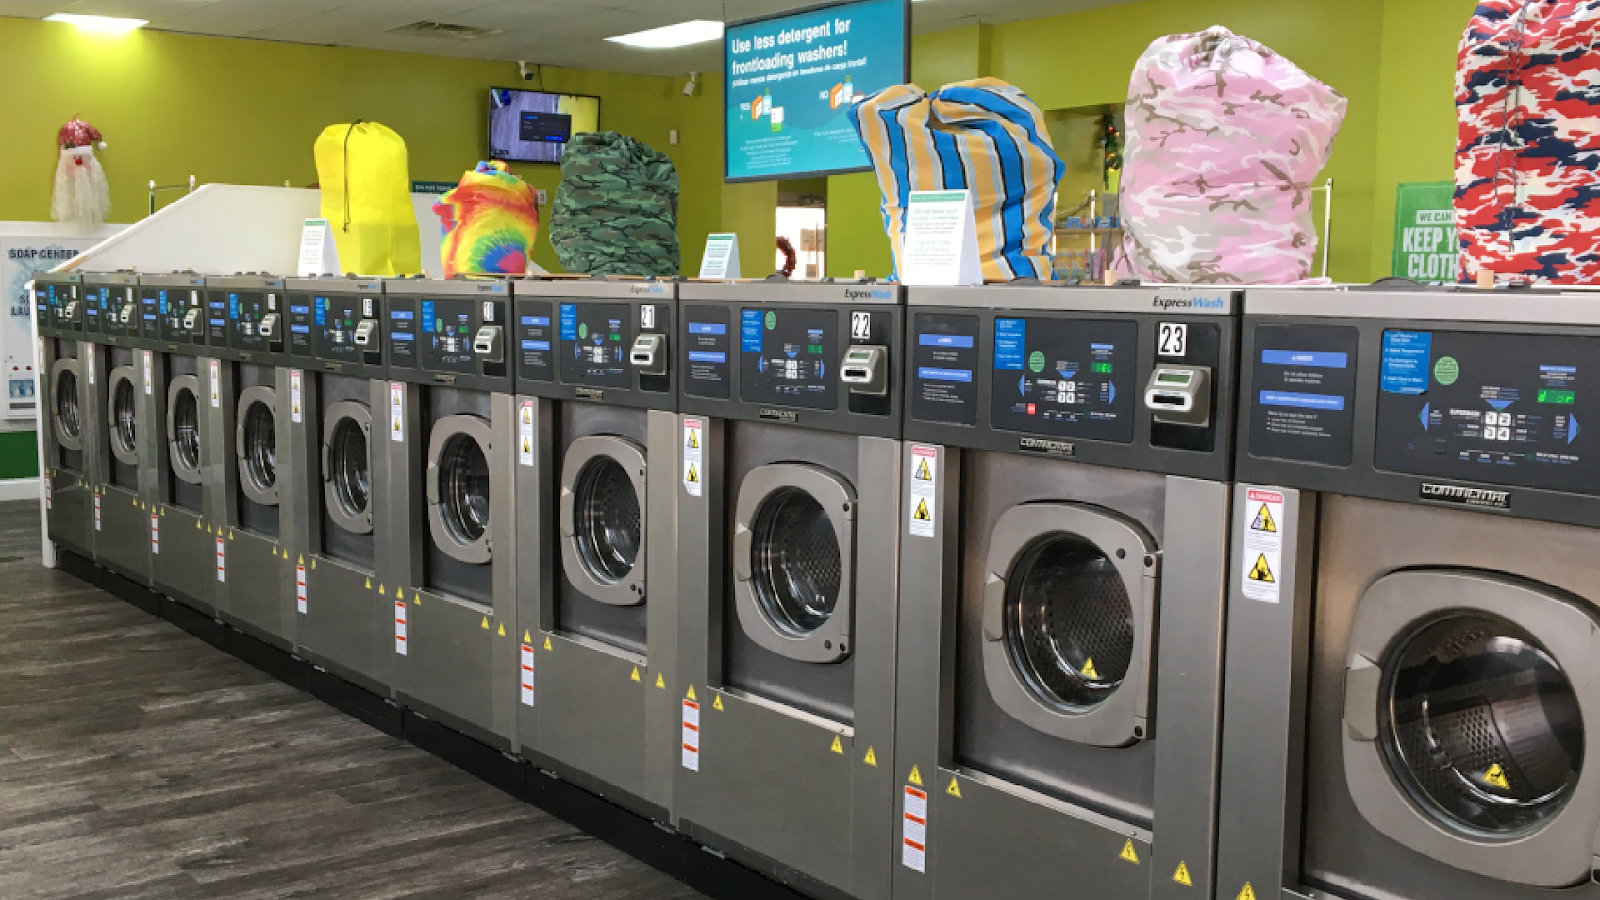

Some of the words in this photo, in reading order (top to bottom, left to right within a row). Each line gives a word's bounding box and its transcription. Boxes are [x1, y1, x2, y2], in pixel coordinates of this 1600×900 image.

[732, 38, 751, 54] Use
[754, 35, 775, 50] less
[777, 20, 831, 45] detergent
[834, 18, 852, 35] for
[732, 53, 794, 75] frontloading
[798, 39, 848, 64] washers!
[1420, 213, 1432, 222] WE
[1434, 212, 1452, 222] CAN
[1402, 227, 1443, 252] KEEP
[9, 250, 37, 259] SOAP
[1408, 253, 1458, 278] CLOTH
[854, 314, 868, 336] 22
[1161, 326, 1183, 353] 23
